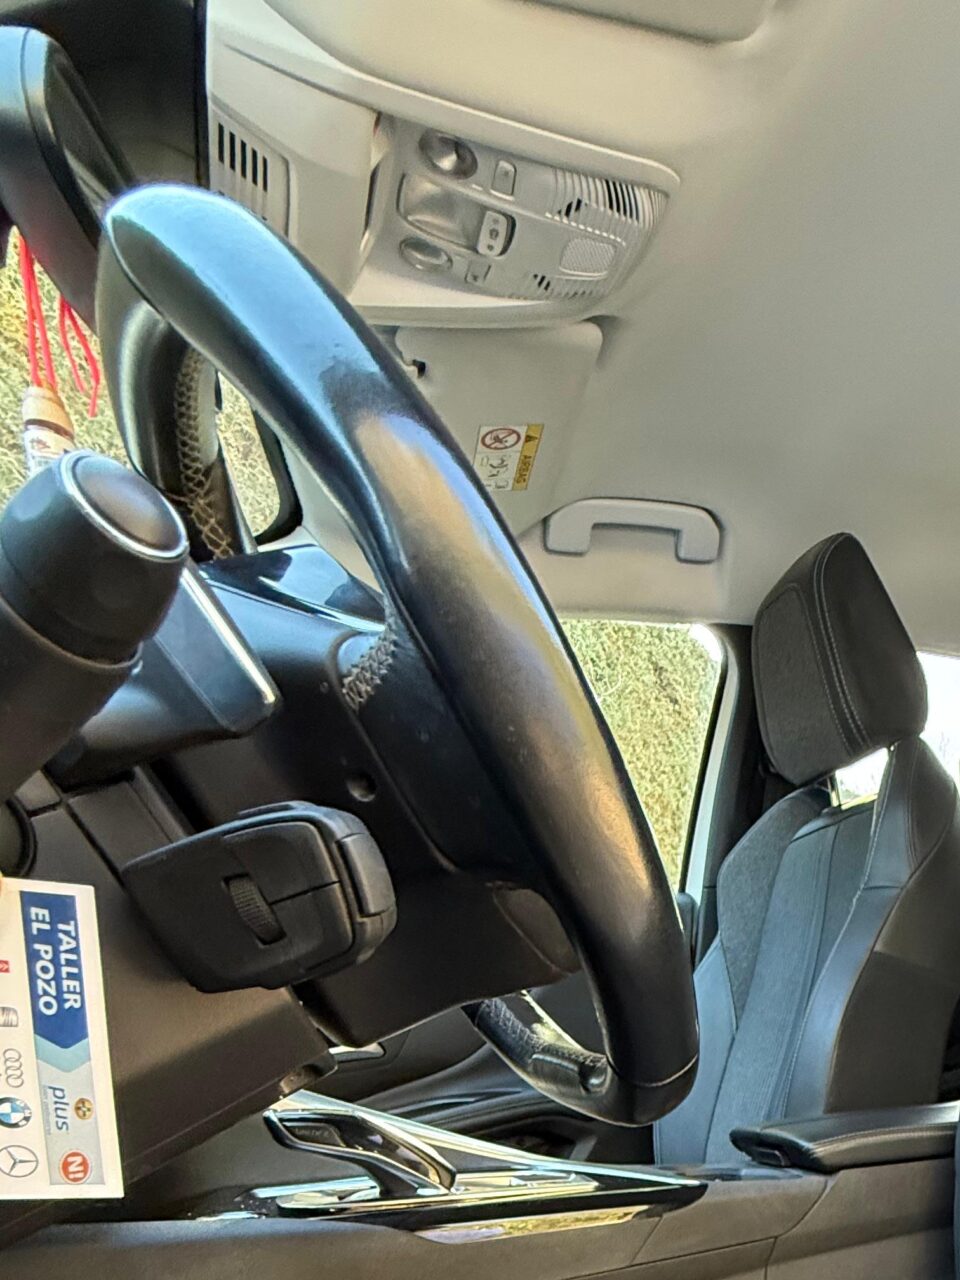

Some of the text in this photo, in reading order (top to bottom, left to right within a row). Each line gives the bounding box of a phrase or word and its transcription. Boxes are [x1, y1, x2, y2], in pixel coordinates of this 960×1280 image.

[29, 906, 58, 1016] EL POZO
[56, 920, 82, 1010] TALLER
[48, 1086, 70, 1131] plus
